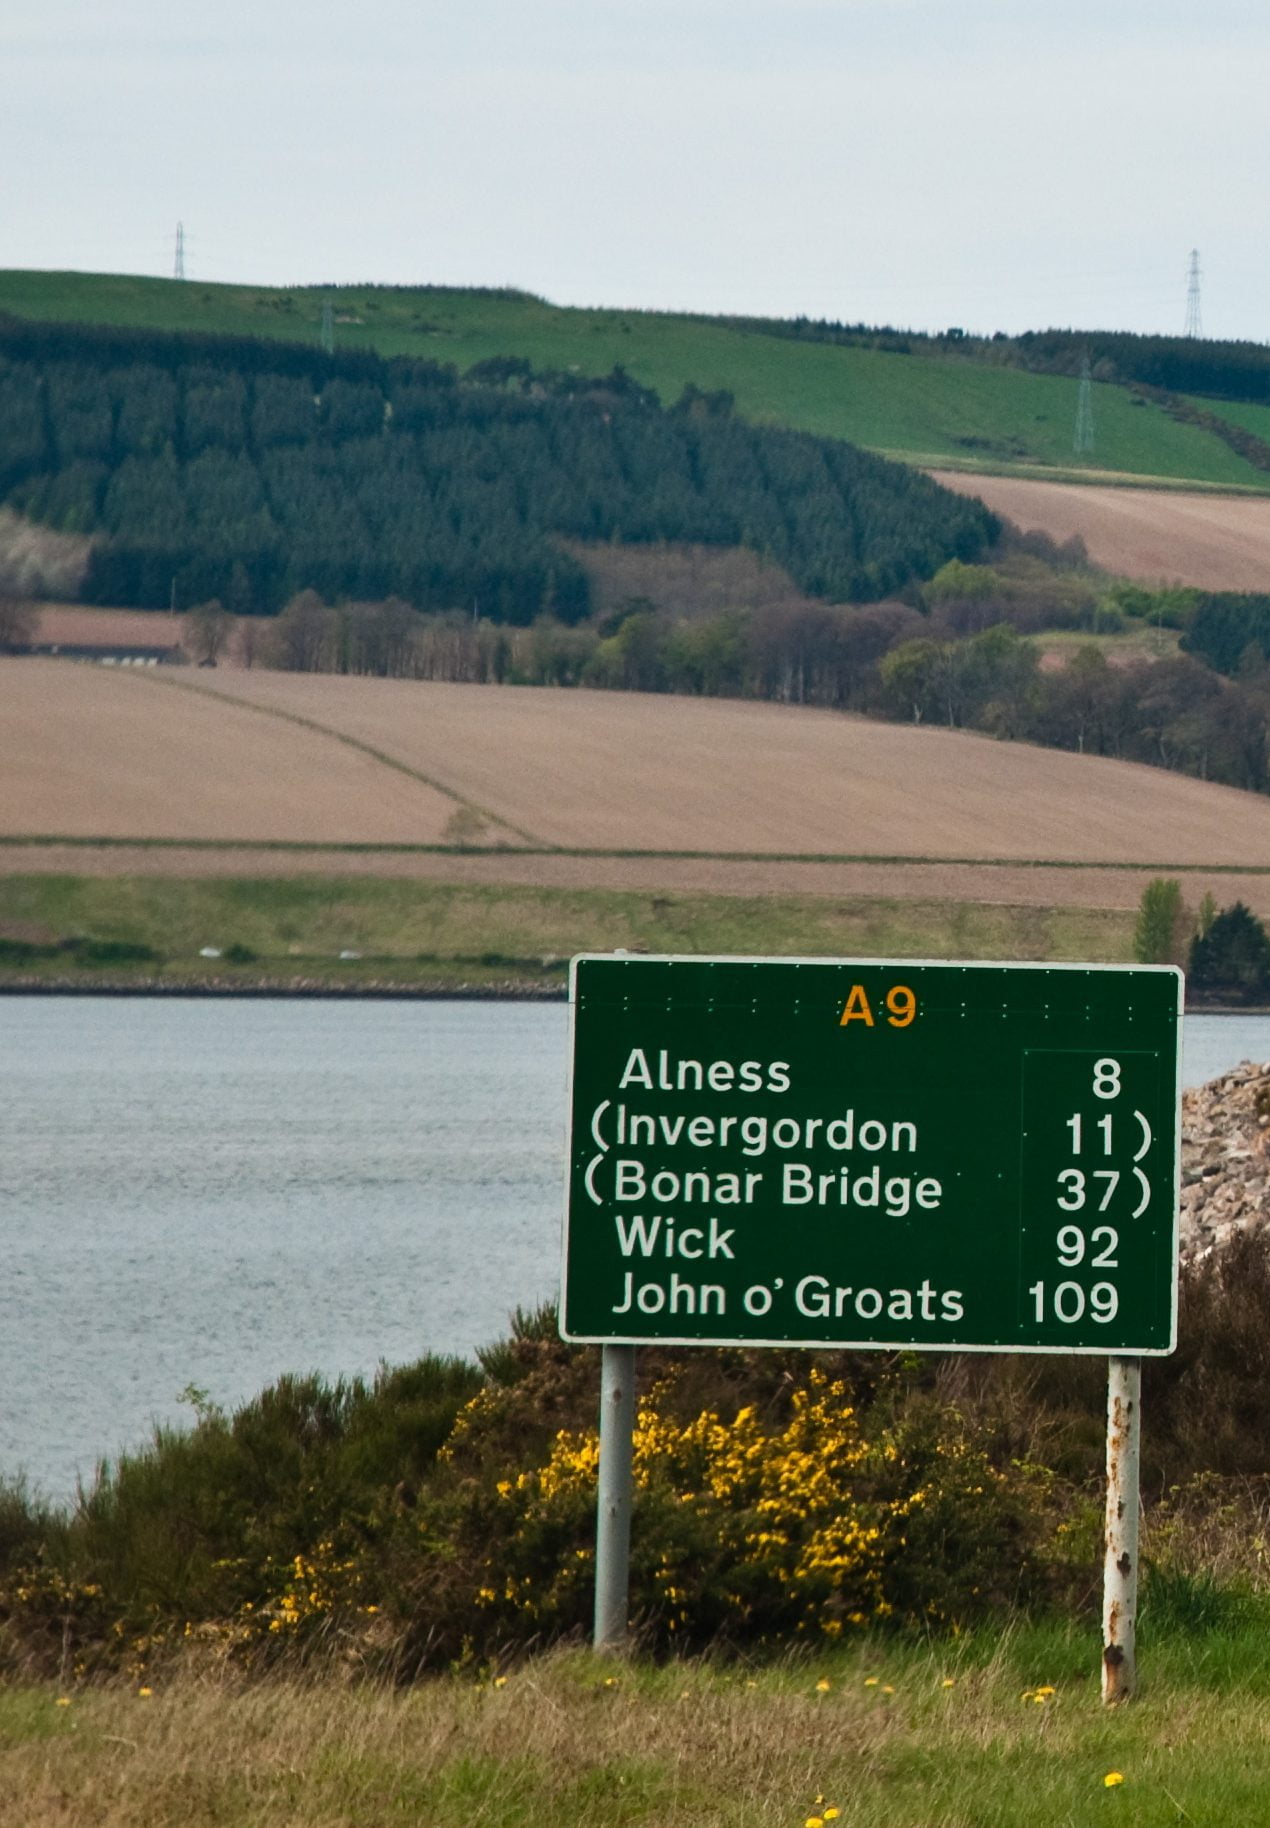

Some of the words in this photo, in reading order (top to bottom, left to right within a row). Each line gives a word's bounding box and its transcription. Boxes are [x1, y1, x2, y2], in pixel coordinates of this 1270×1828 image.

[839, 984, 917, 1029] A9
[618, 1047, 792, 1094] Alness
[1091, 1057, 1122, 1100] 8
[590, 1098, 918, 1157] (Invergordon
[1065, 1109, 1153, 1163] 11)
[583, 1152, 764, 1206] (Bonar
[781, 1162, 943, 1218] Bridge
[1056, 1165, 1152, 1220] 37)
[614, 1214, 736, 1260] Wick
[1055, 1224, 1120, 1269] 92
[611, 1271, 726, 1316] John
[794, 1274, 965, 1323] Groats
[1028, 1279, 1120, 1324] 109
